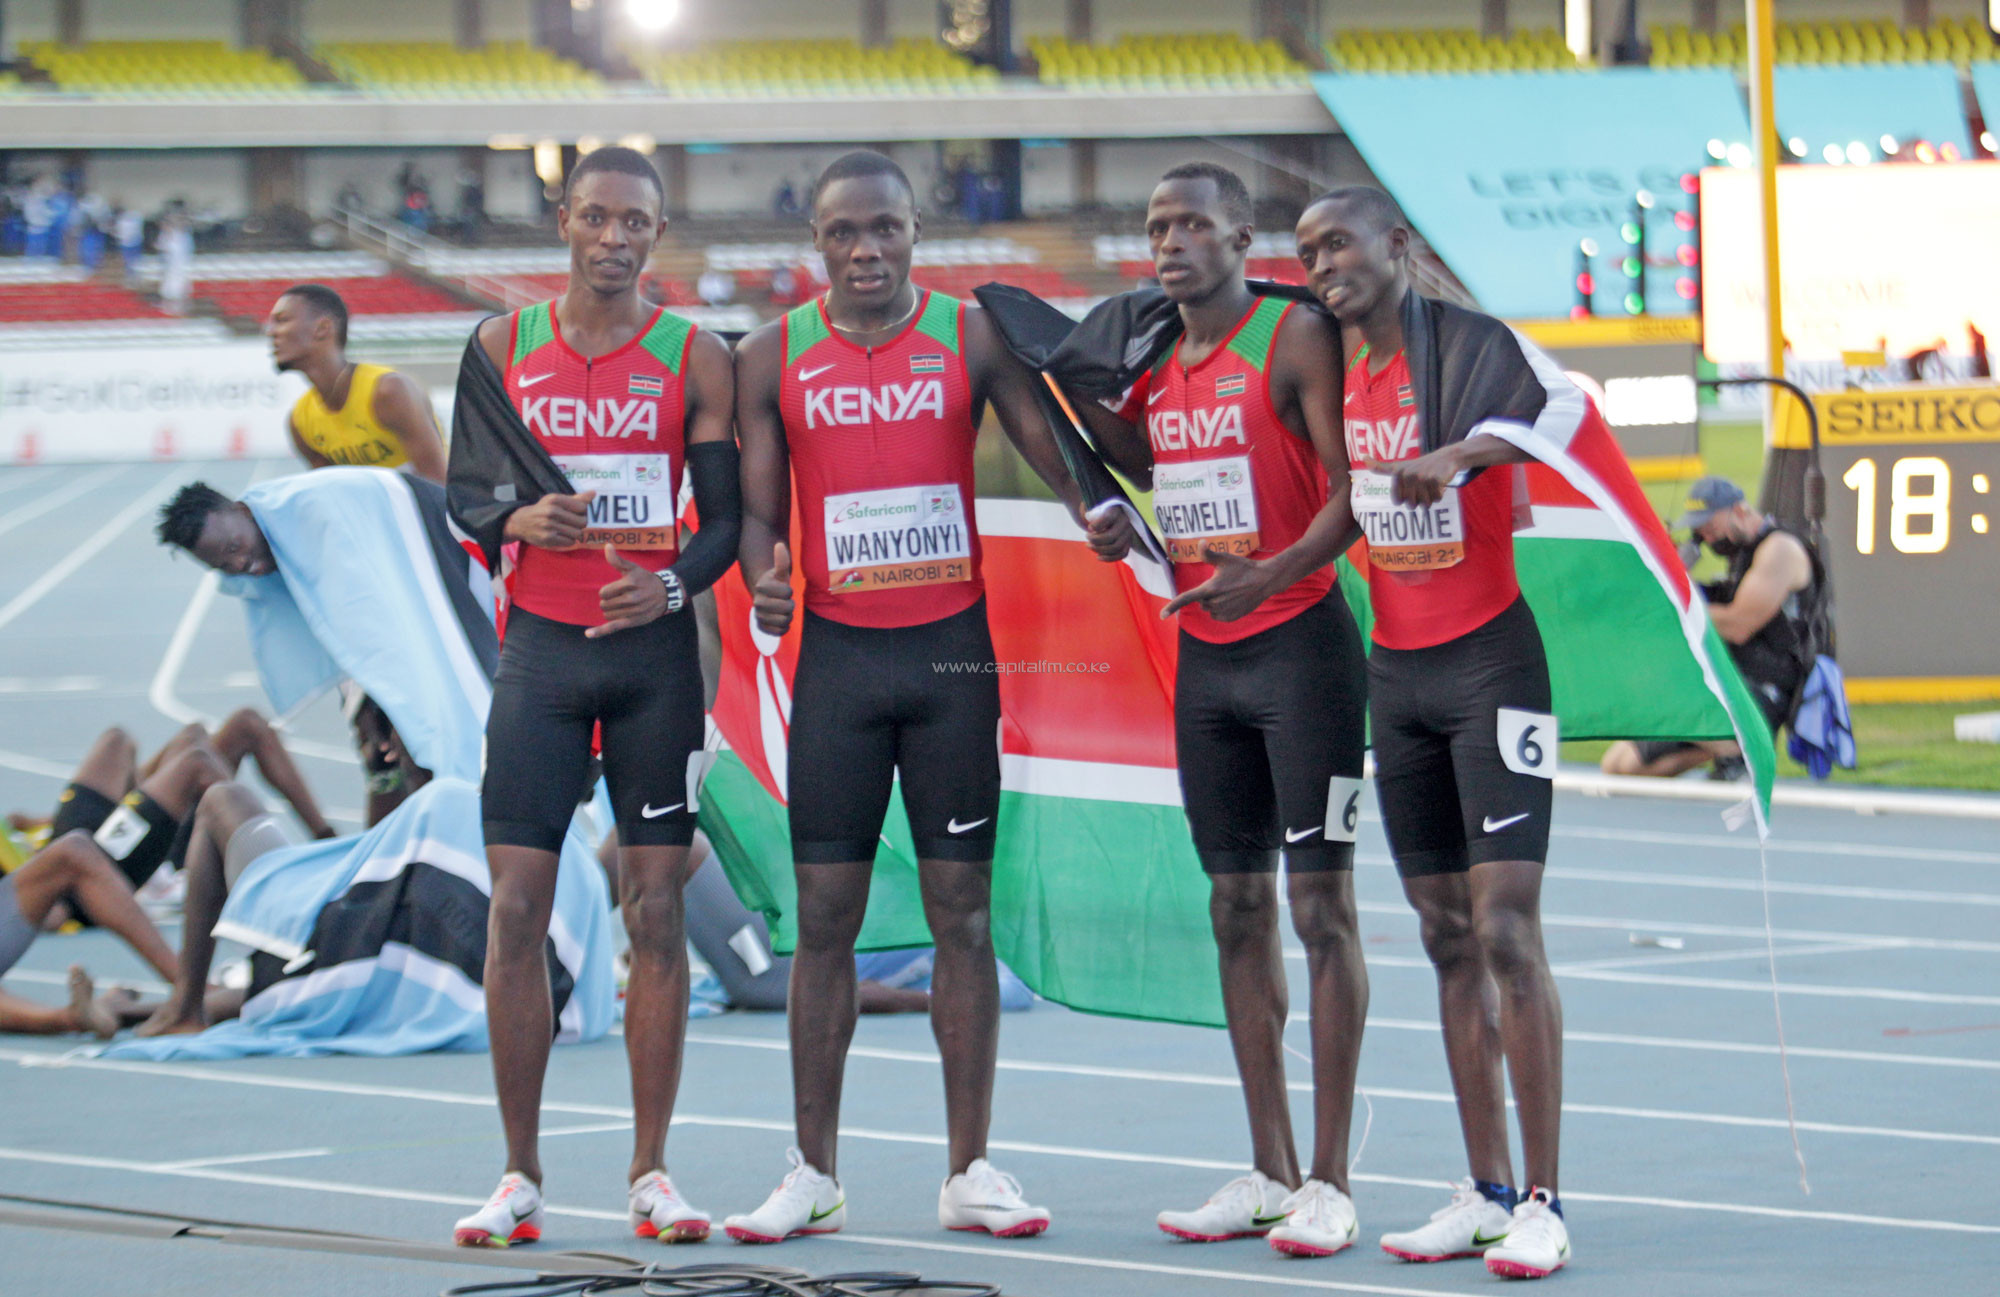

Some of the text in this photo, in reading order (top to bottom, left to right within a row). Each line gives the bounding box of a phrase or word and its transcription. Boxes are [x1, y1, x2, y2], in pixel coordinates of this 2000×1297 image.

[522, 397, 657, 440] KENYA
[806, 380, 943, 429] KENYA
[1828, 396, 2000, 436] SEIKO
[1148, 404, 1246, 452] KENYA
[1344, 414, 1419, 462] KENYA
[564, 468, 621, 480] afaricom
[1159, 476, 1205, 492] Safaricom
[1362, 484, 1392, 496] Safaric
[587, 495, 649, 524] MEU
[847, 502, 917, 520] Safaricom
[1156, 499, 1249, 535] CHEMELIL
[646, 532, 665, 544] 21
[833, 523, 962, 565] WANYONYI
[1181, 539, 1251, 558] NAOBI 21
[872, 563, 964, 585] NAIROBI 21
[1517, 724, 1543, 768] 6
[1342, 789, 1360, 834] 6
